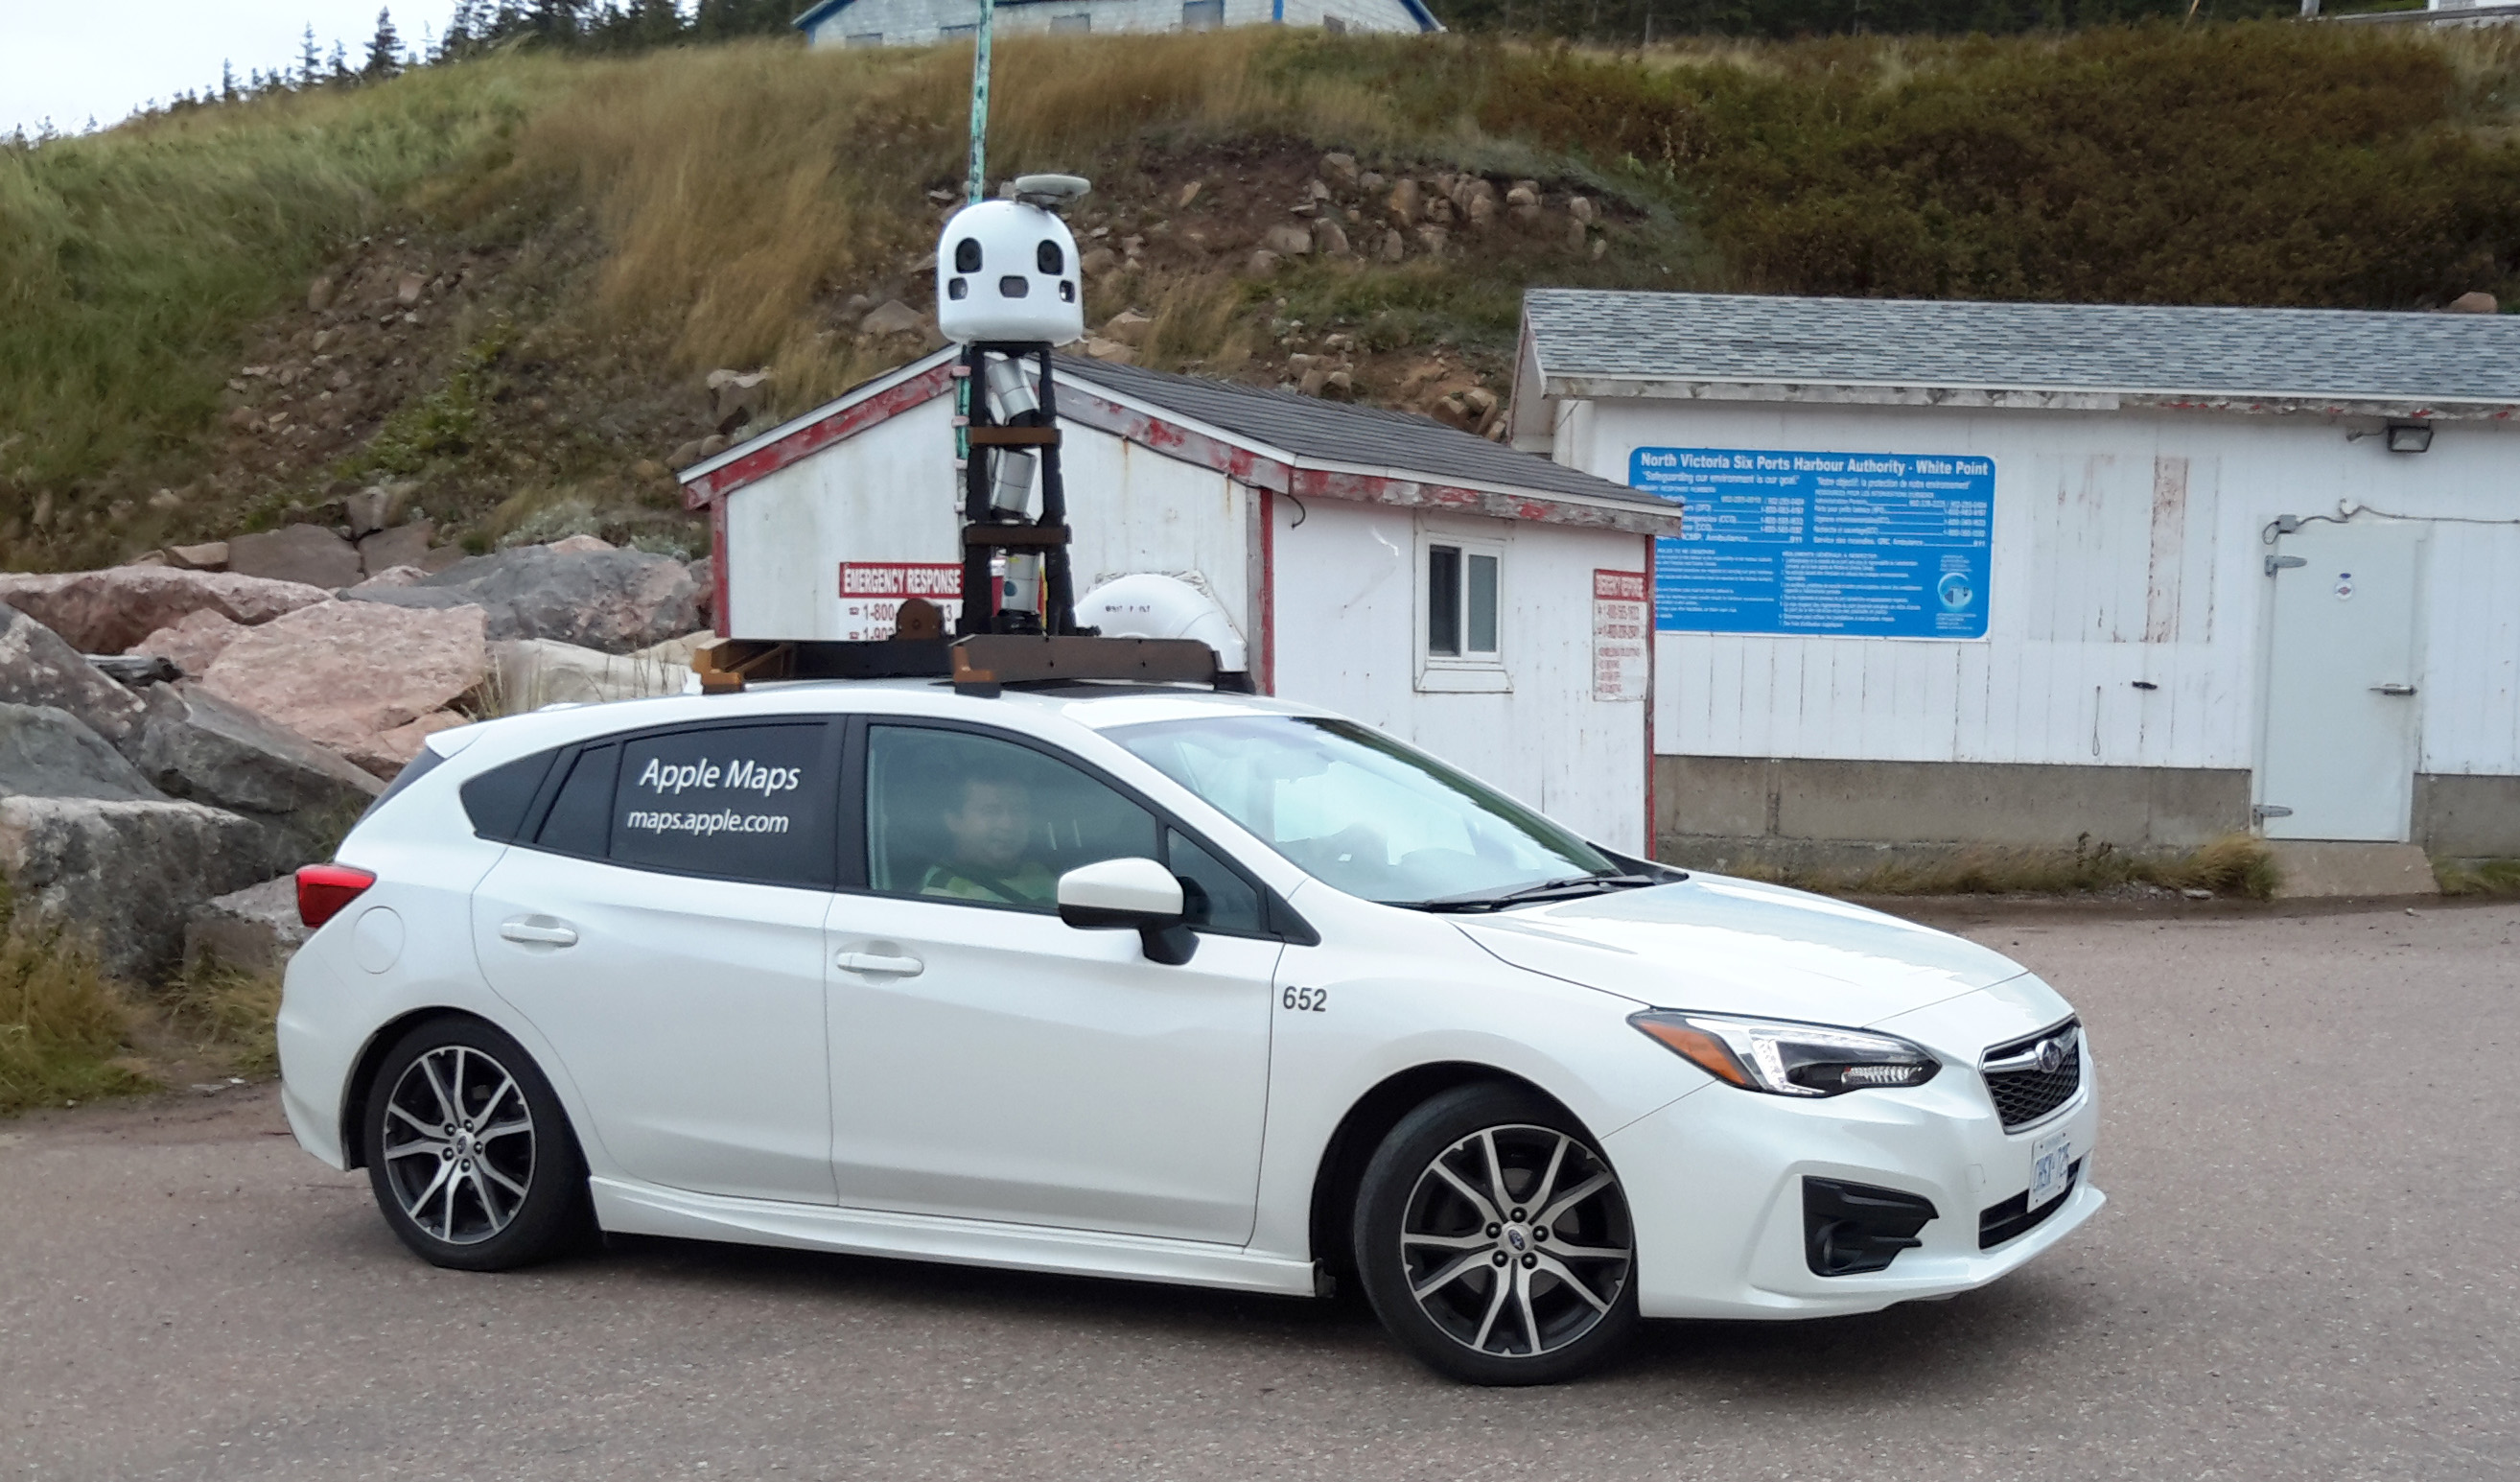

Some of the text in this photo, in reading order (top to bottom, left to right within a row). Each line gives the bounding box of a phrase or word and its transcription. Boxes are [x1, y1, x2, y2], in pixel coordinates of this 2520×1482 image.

[1641, 452, 1676, 467] North
[1680, 453, 1730, 469] Victoria
[1734, 455, 1754, 470] Six
[1757, 456, 1790, 471] Ports
[1794, 457, 1844, 472] Harbour
[1847, 458, 1906, 478] Authority
[1916, 459, 1952, 475] White
[1955, 460, 1989, 476] Point
[844, 568, 962, 595] EMERGENCY RESPONSE
[639, 757, 801, 797] Apple Maps
[626, 809, 789, 836] maps.apple.com
[1283, 985, 1327, 1012] 652
